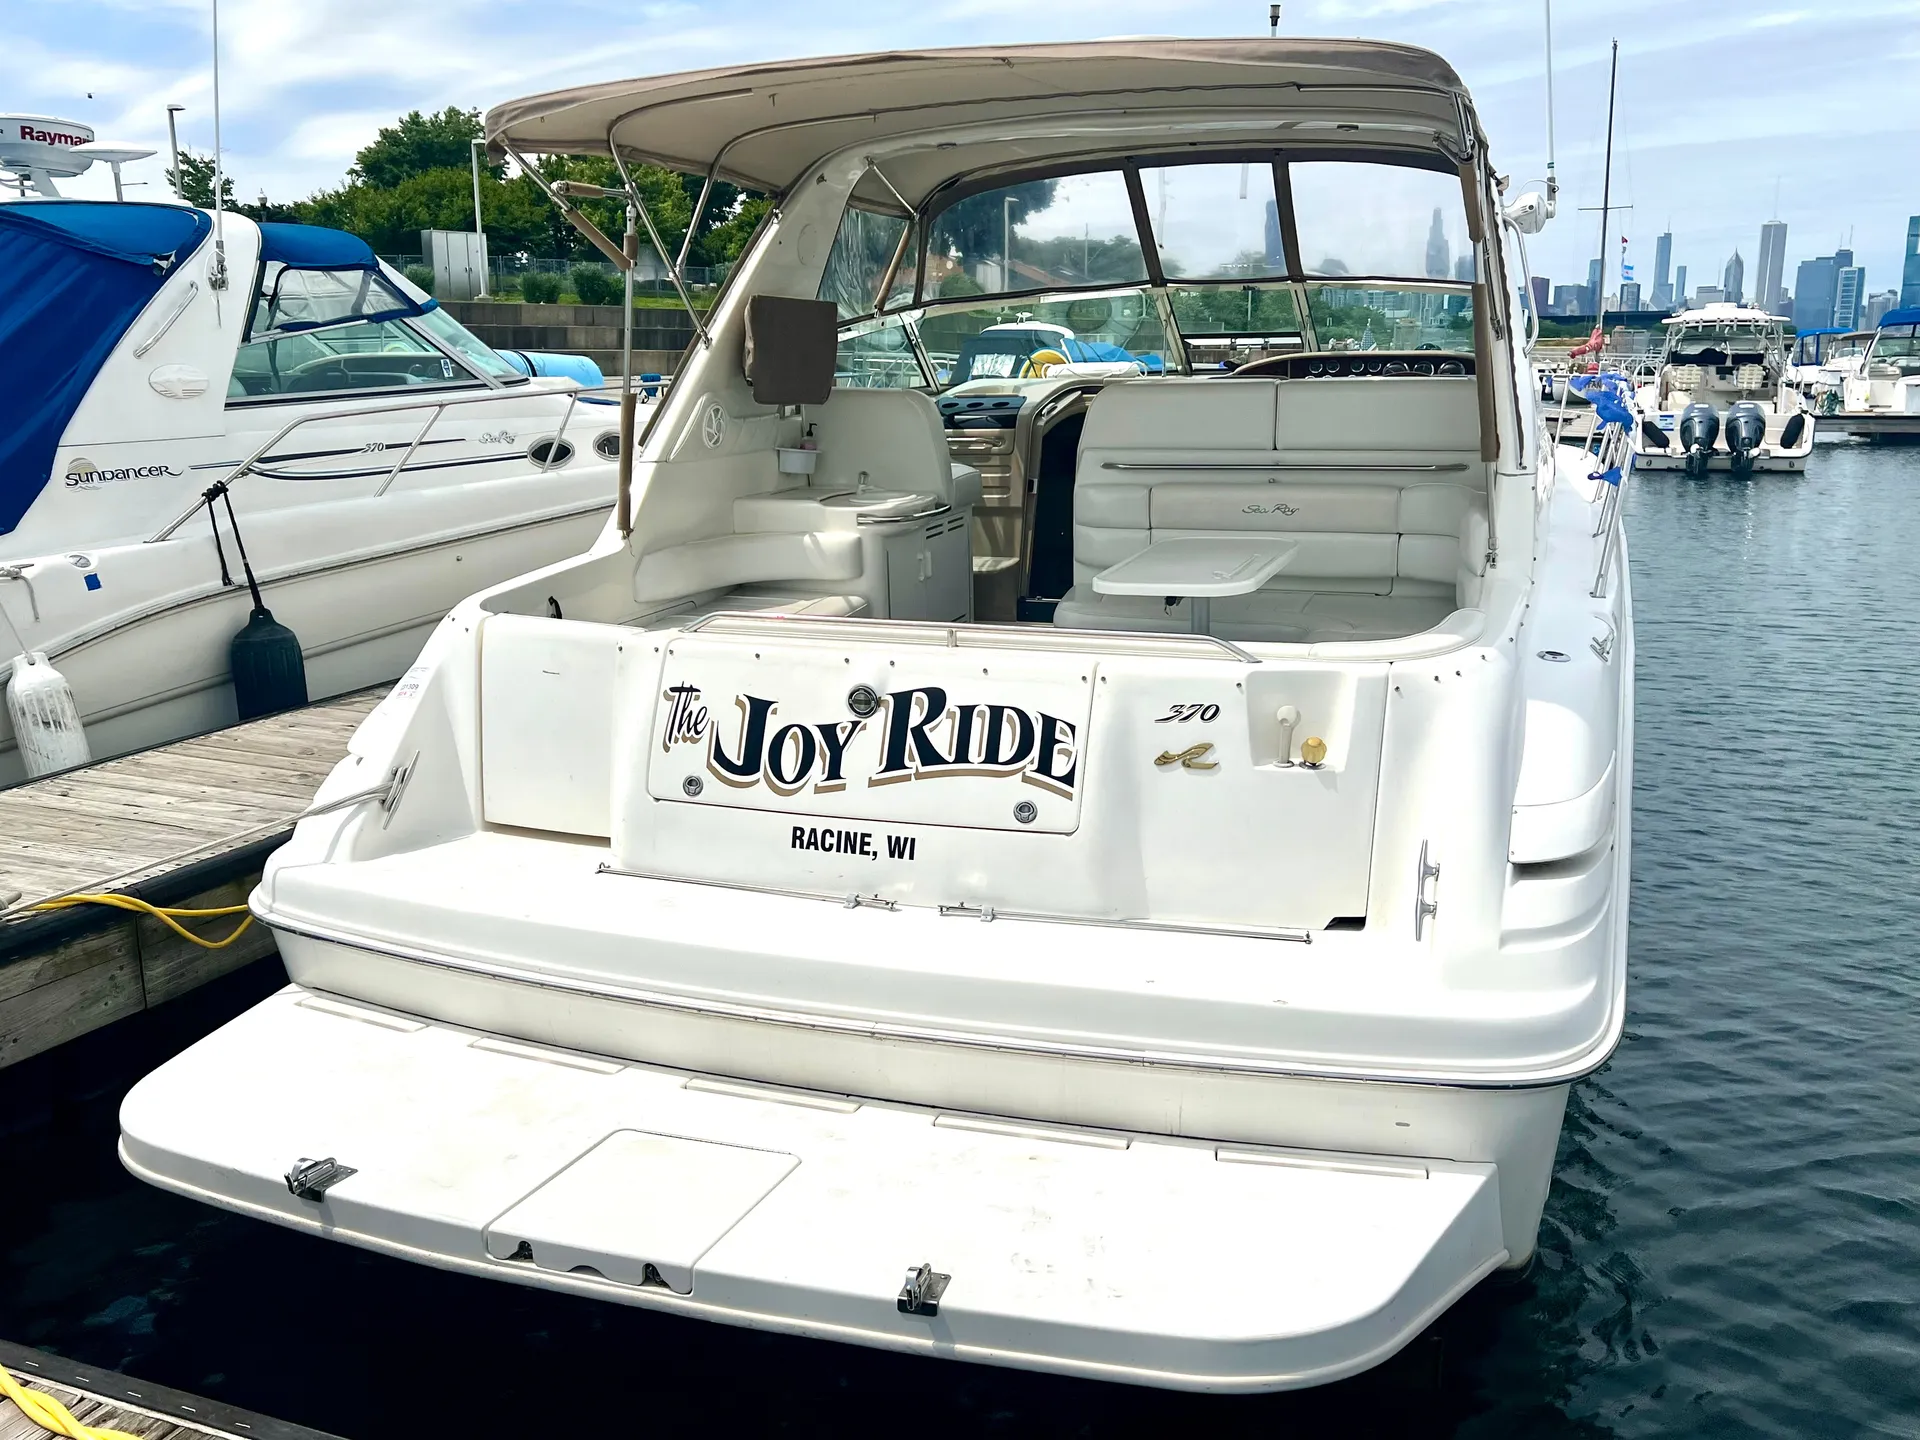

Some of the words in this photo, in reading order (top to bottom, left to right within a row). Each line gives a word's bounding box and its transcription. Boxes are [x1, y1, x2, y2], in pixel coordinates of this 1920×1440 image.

[361, 442, 385, 453] 370
[1241, 503, 1270, 514] Sea
[1270, 503, 1300, 517] Ray
[1154, 703, 1222, 724] 370
[664, 681, 710, 751] The
[706, 693, 867, 797] JOY
[868, 686, 1078, 801] RIDE
[791, 826, 878, 861] RACINE,
[887, 835, 916, 860] WI
